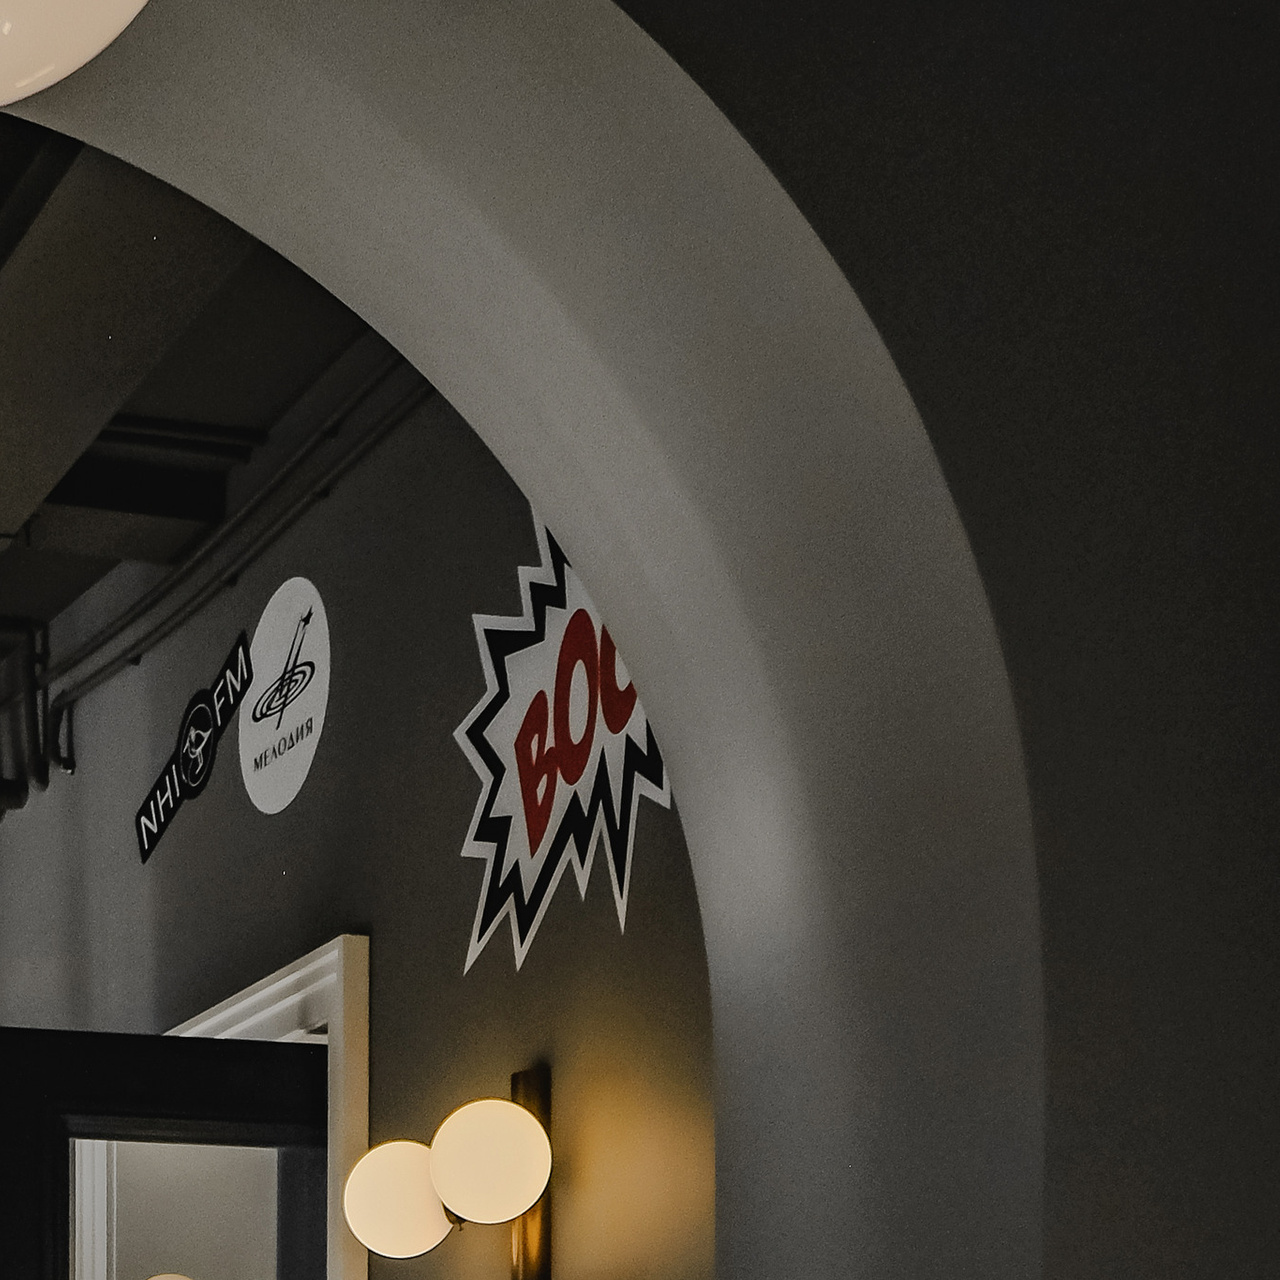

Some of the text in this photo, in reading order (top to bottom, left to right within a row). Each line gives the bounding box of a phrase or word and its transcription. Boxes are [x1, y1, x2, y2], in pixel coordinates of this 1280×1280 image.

[139, 644, 248, 850] NHI FM
[253, 716, 314, 773] МЕЛОДИЯ
